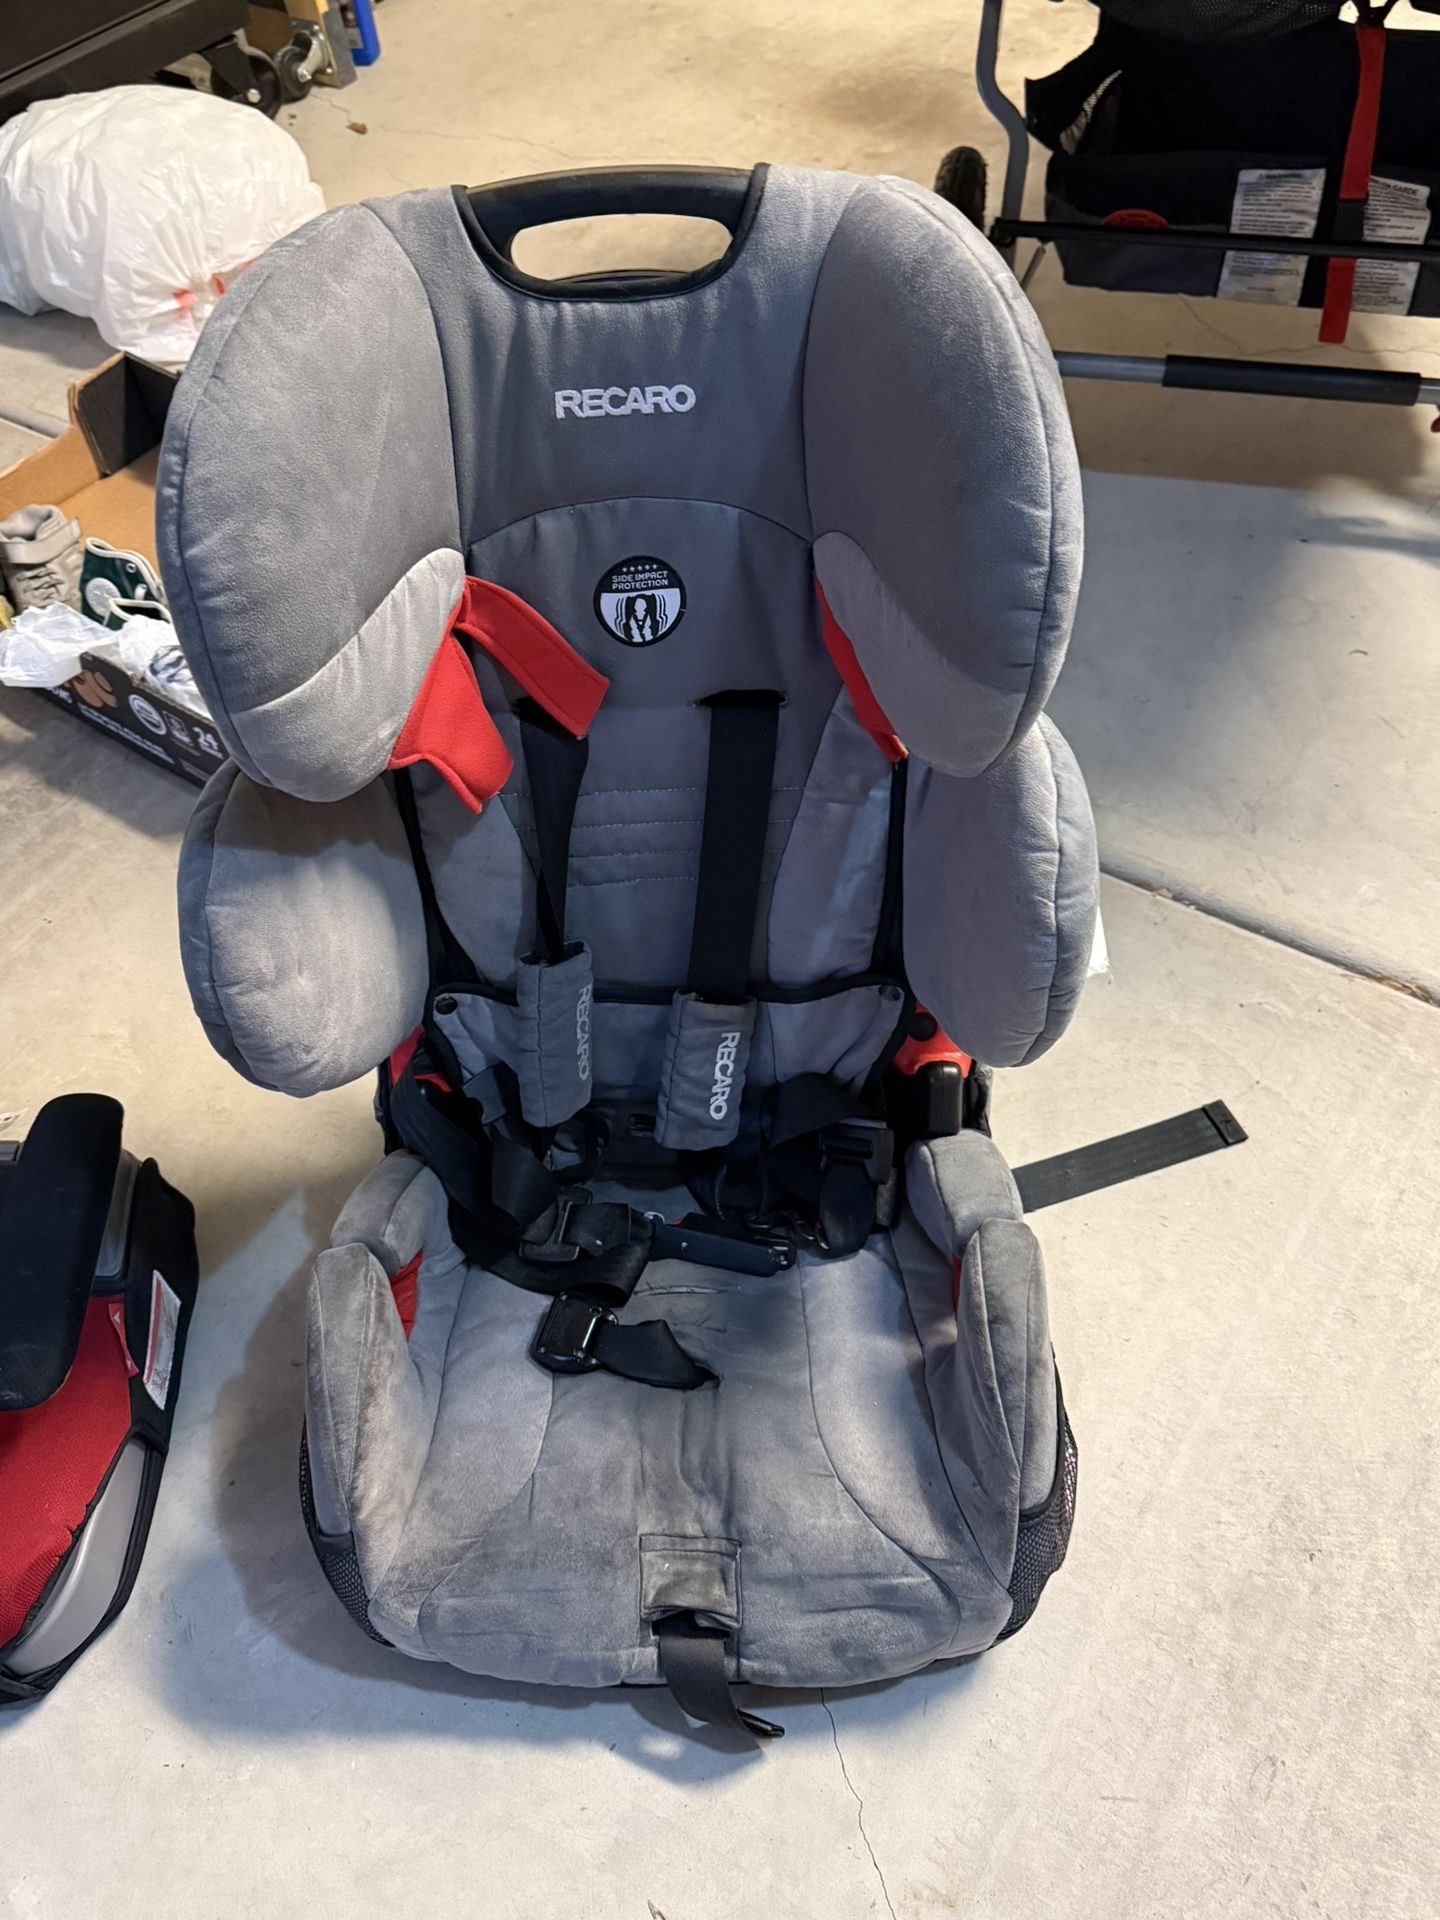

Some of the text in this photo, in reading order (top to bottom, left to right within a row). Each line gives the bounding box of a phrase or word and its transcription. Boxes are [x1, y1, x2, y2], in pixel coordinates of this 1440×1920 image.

[555, 384, 696, 419] RECARO
[612, 570, 668, 583] SIDE IMPACT
[612, 579, 668, 590] PROTECTION
[576, 983, 592, 1081] RECARO
[709, 1031, 741, 1121] RECARO
